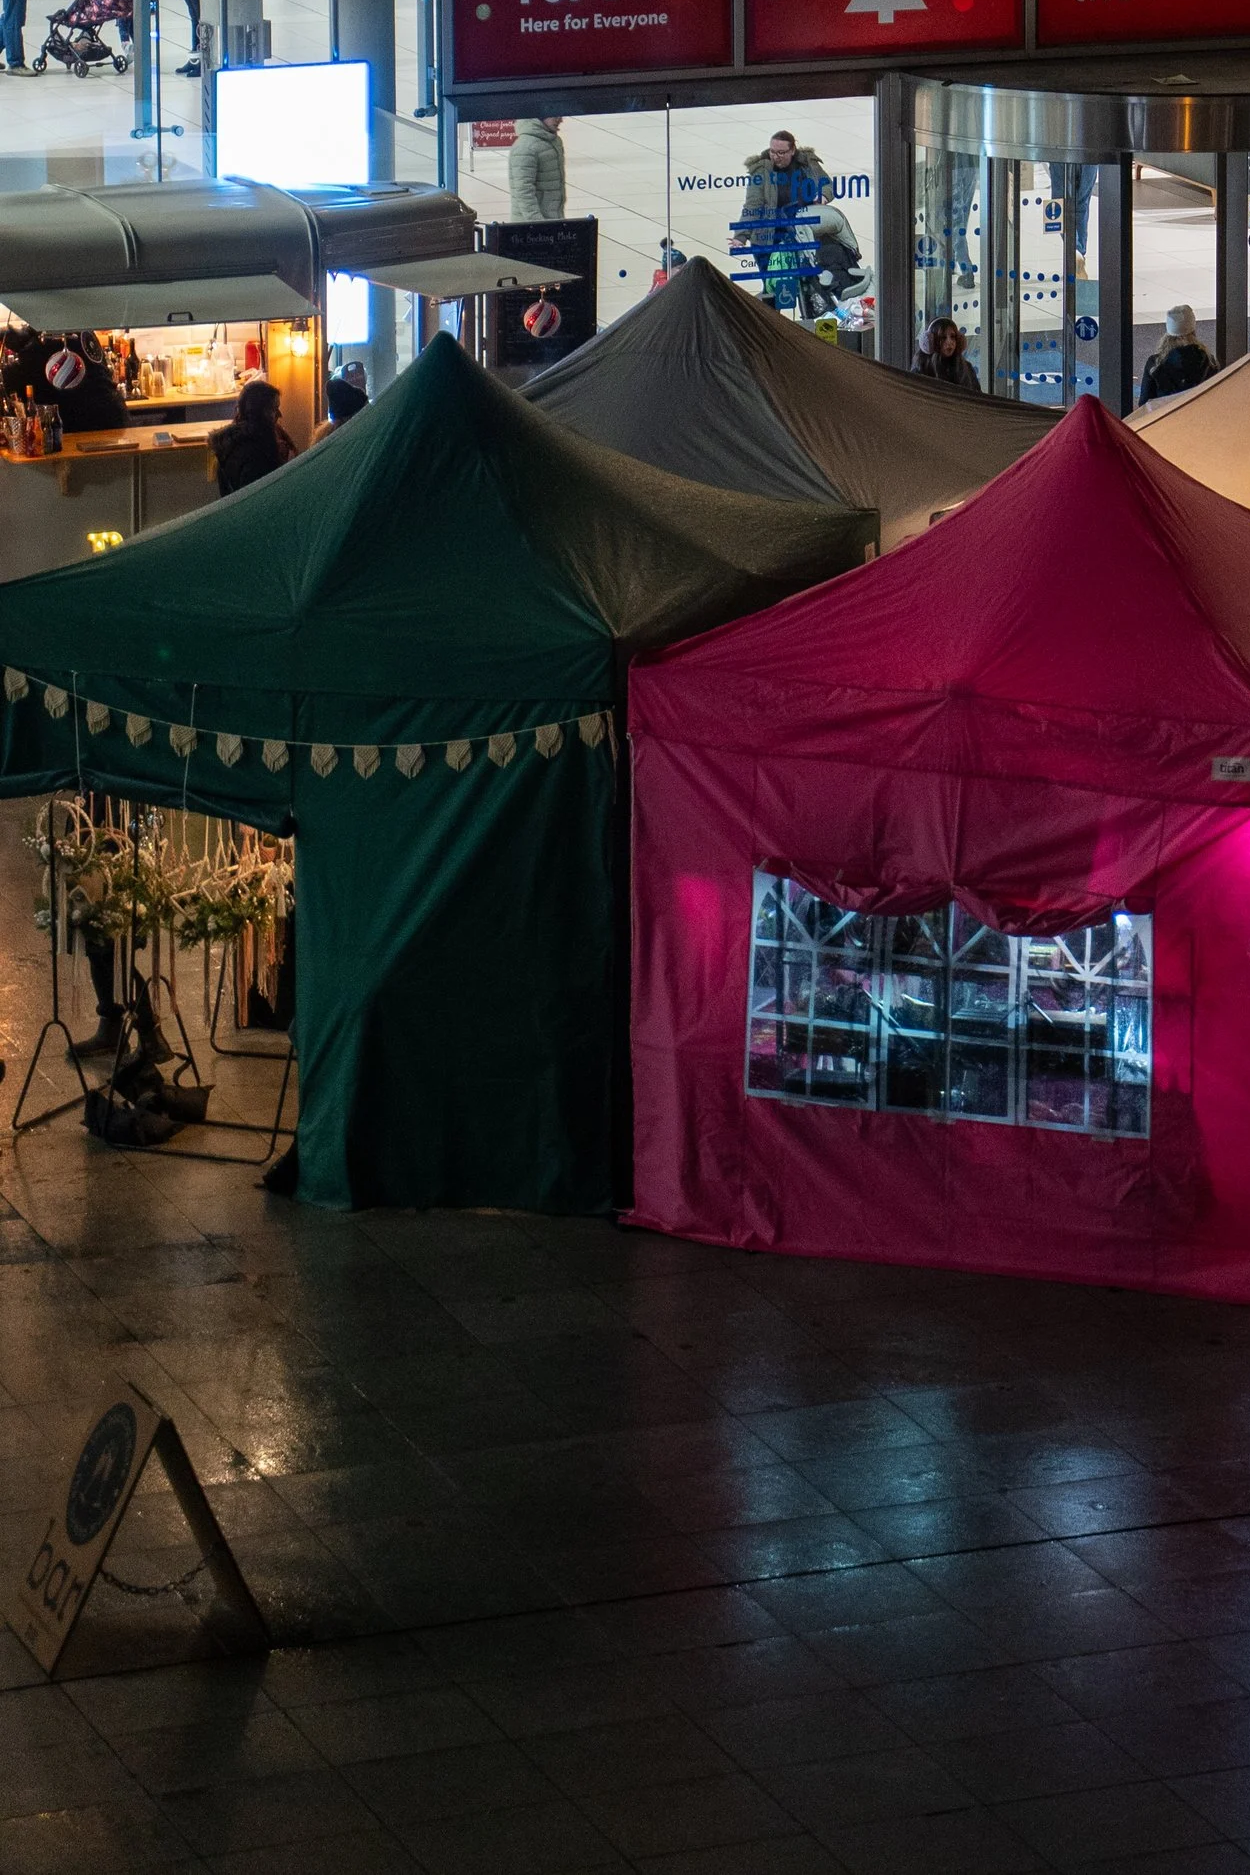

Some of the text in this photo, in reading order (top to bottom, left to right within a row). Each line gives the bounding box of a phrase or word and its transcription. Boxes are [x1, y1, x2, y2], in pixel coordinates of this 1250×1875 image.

[520, 12, 668, 33] Here for Everyone
[678, 169, 870, 204] Welcome to forum
[1219, 761, 1245, 773] titan
[26, 1516, 86, 1622] bar
